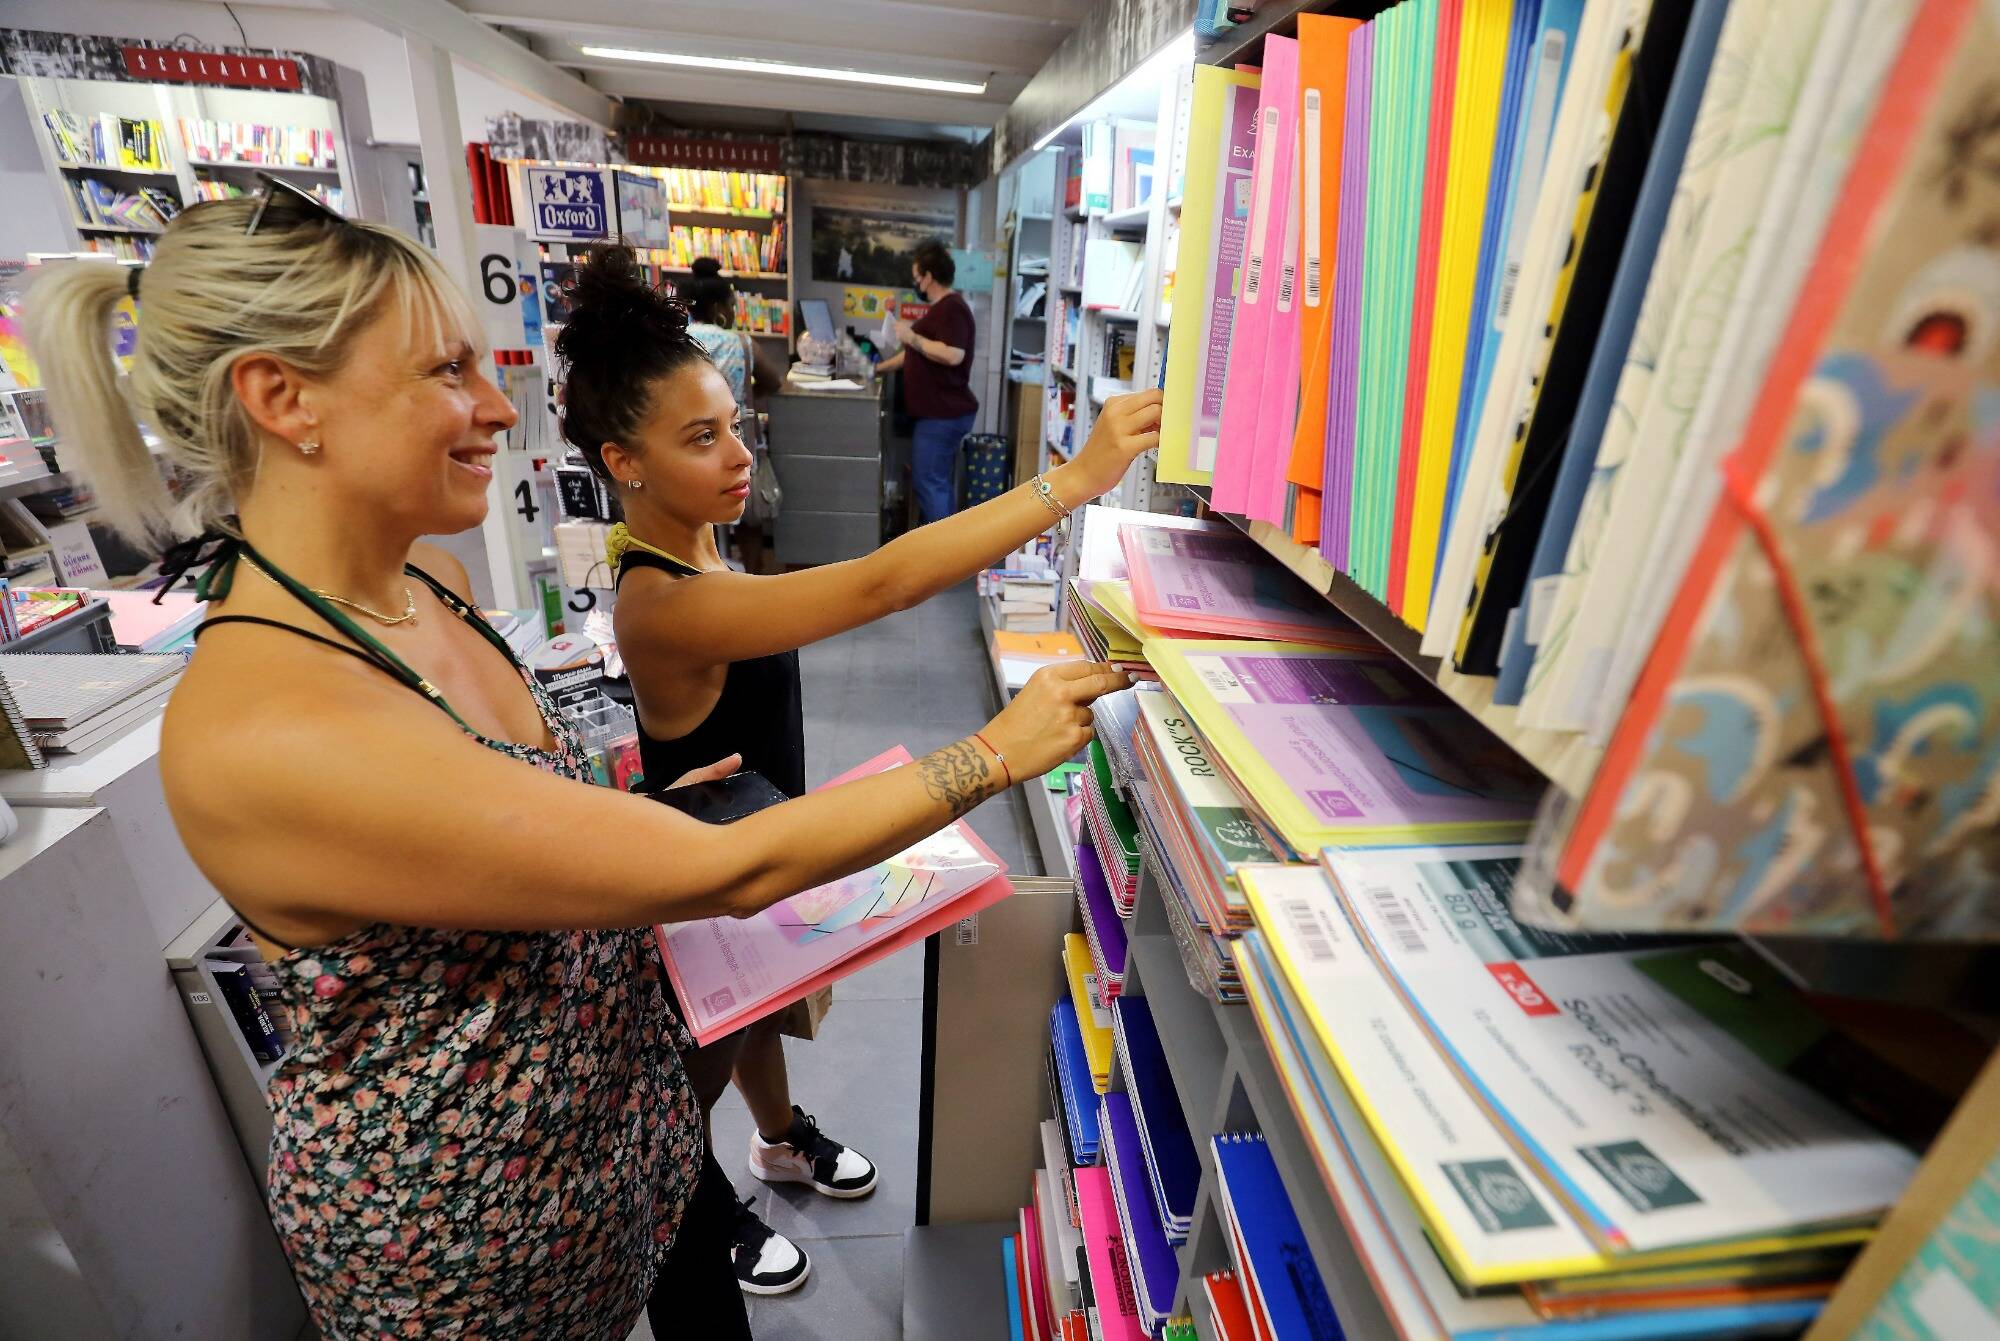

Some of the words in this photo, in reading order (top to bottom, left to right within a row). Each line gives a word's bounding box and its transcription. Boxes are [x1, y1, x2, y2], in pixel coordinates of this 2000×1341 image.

[138, 54, 287, 82] SCOLAIRE
[638, 141, 769, 163] PARASCOLAIRE
[544, 204, 596, 230] Oxford
[480, 253, 517, 305] 6
